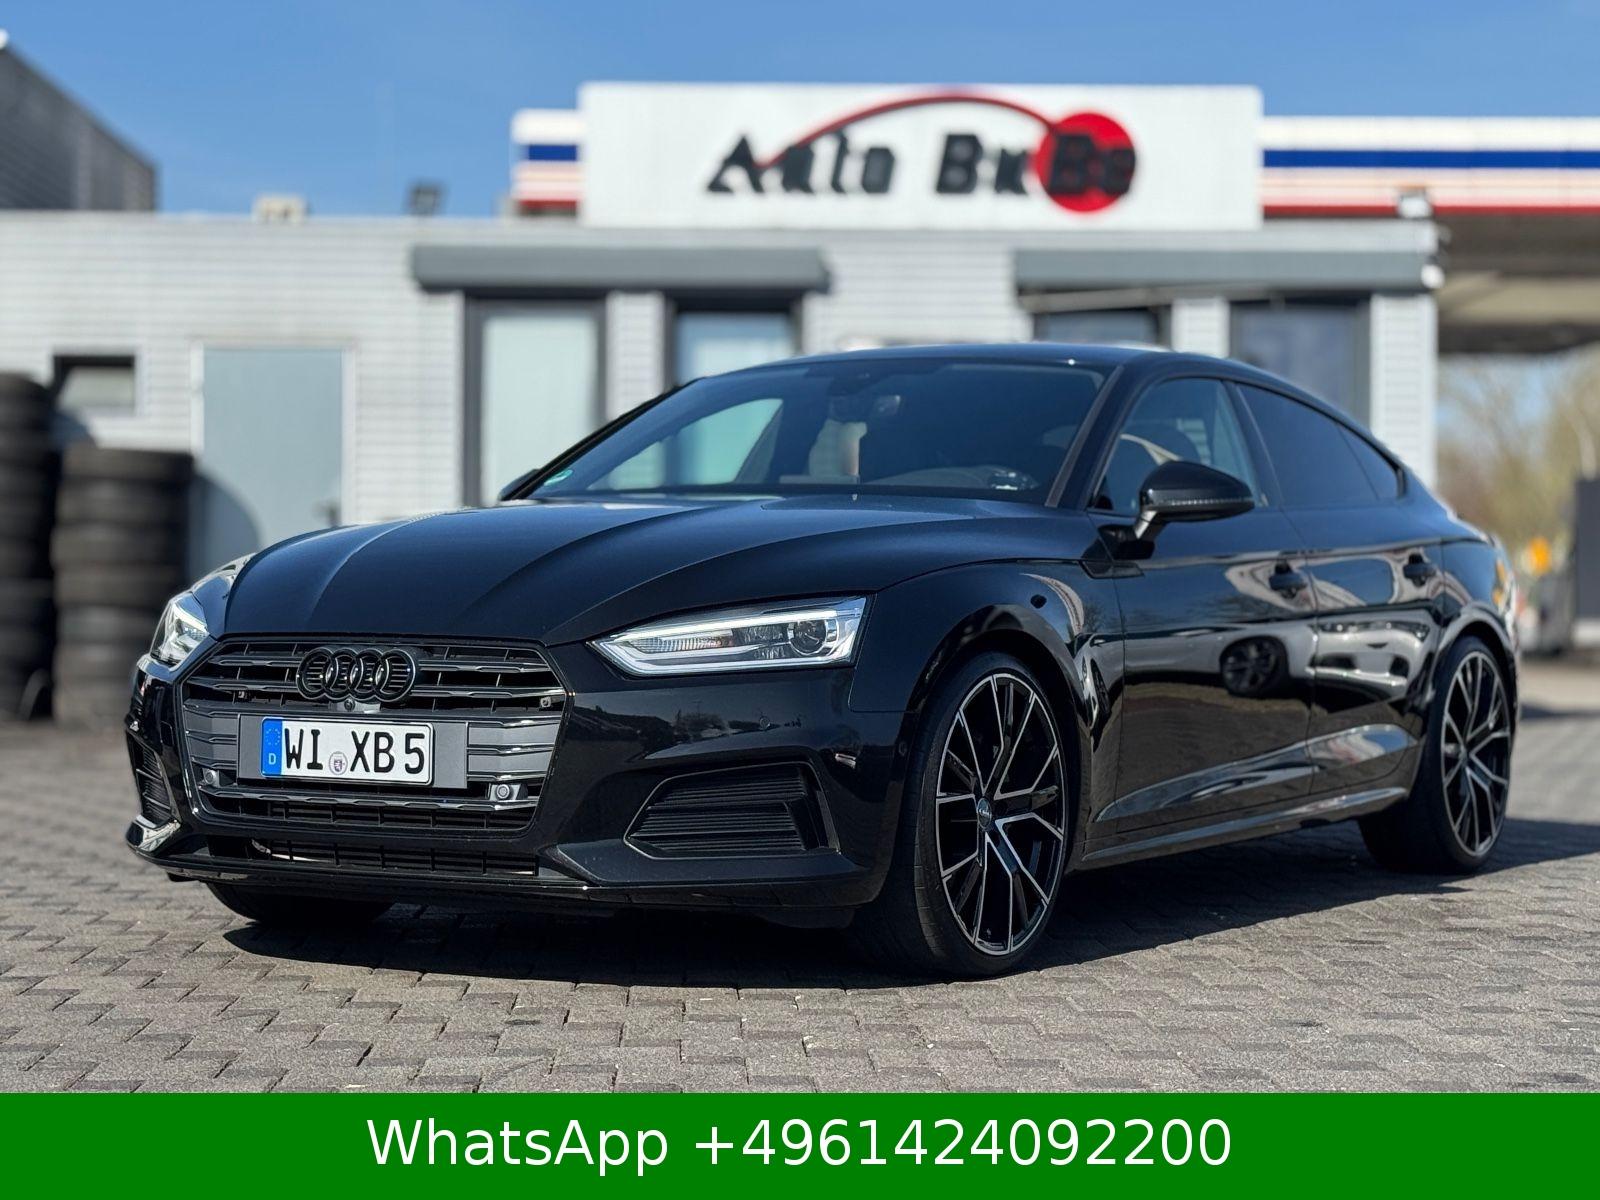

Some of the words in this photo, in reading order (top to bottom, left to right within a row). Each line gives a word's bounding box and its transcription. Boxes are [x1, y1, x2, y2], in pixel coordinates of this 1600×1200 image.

[707, 134, 895, 193] Auto
[268, 752, 276, 765] D
[284, 728, 323, 770] WI
[350, 730, 395, 773] XB
[404, 732, 425, 774] 5
